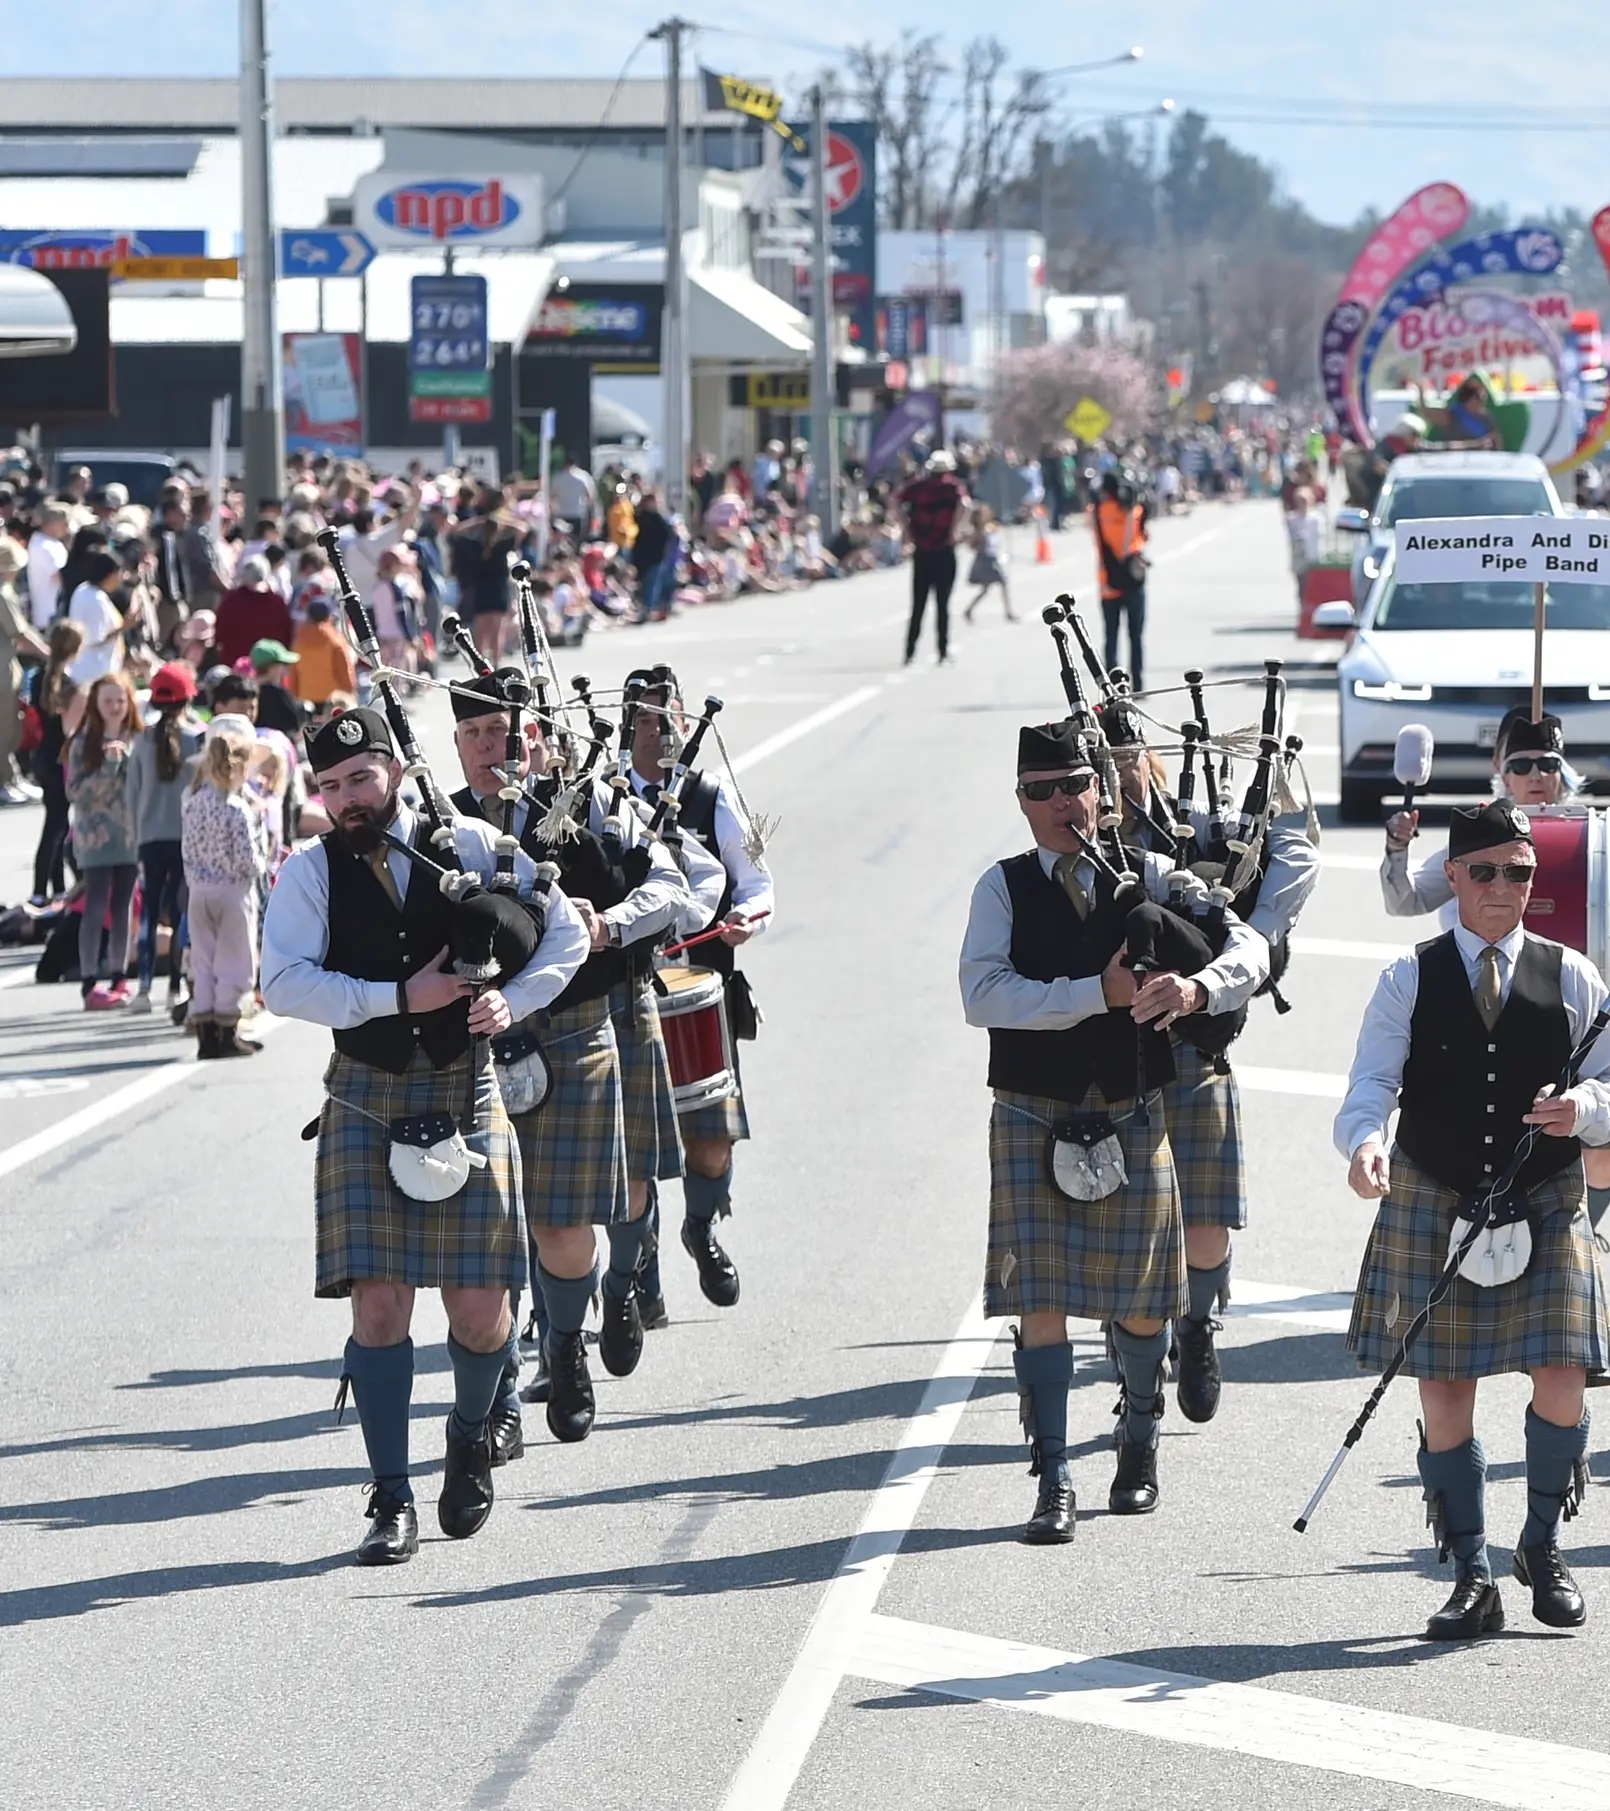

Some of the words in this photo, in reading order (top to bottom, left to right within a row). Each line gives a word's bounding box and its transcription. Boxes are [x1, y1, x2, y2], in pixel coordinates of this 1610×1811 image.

[394, 179, 504, 240] npd
[1422, 338, 1541, 373] Festiva
[1405, 533, 1514, 551] Alexandra
[1531, 532, 1572, 549] And
[1481, 553, 1528, 572] Pipe
[1545, 555, 1599, 573] Band
